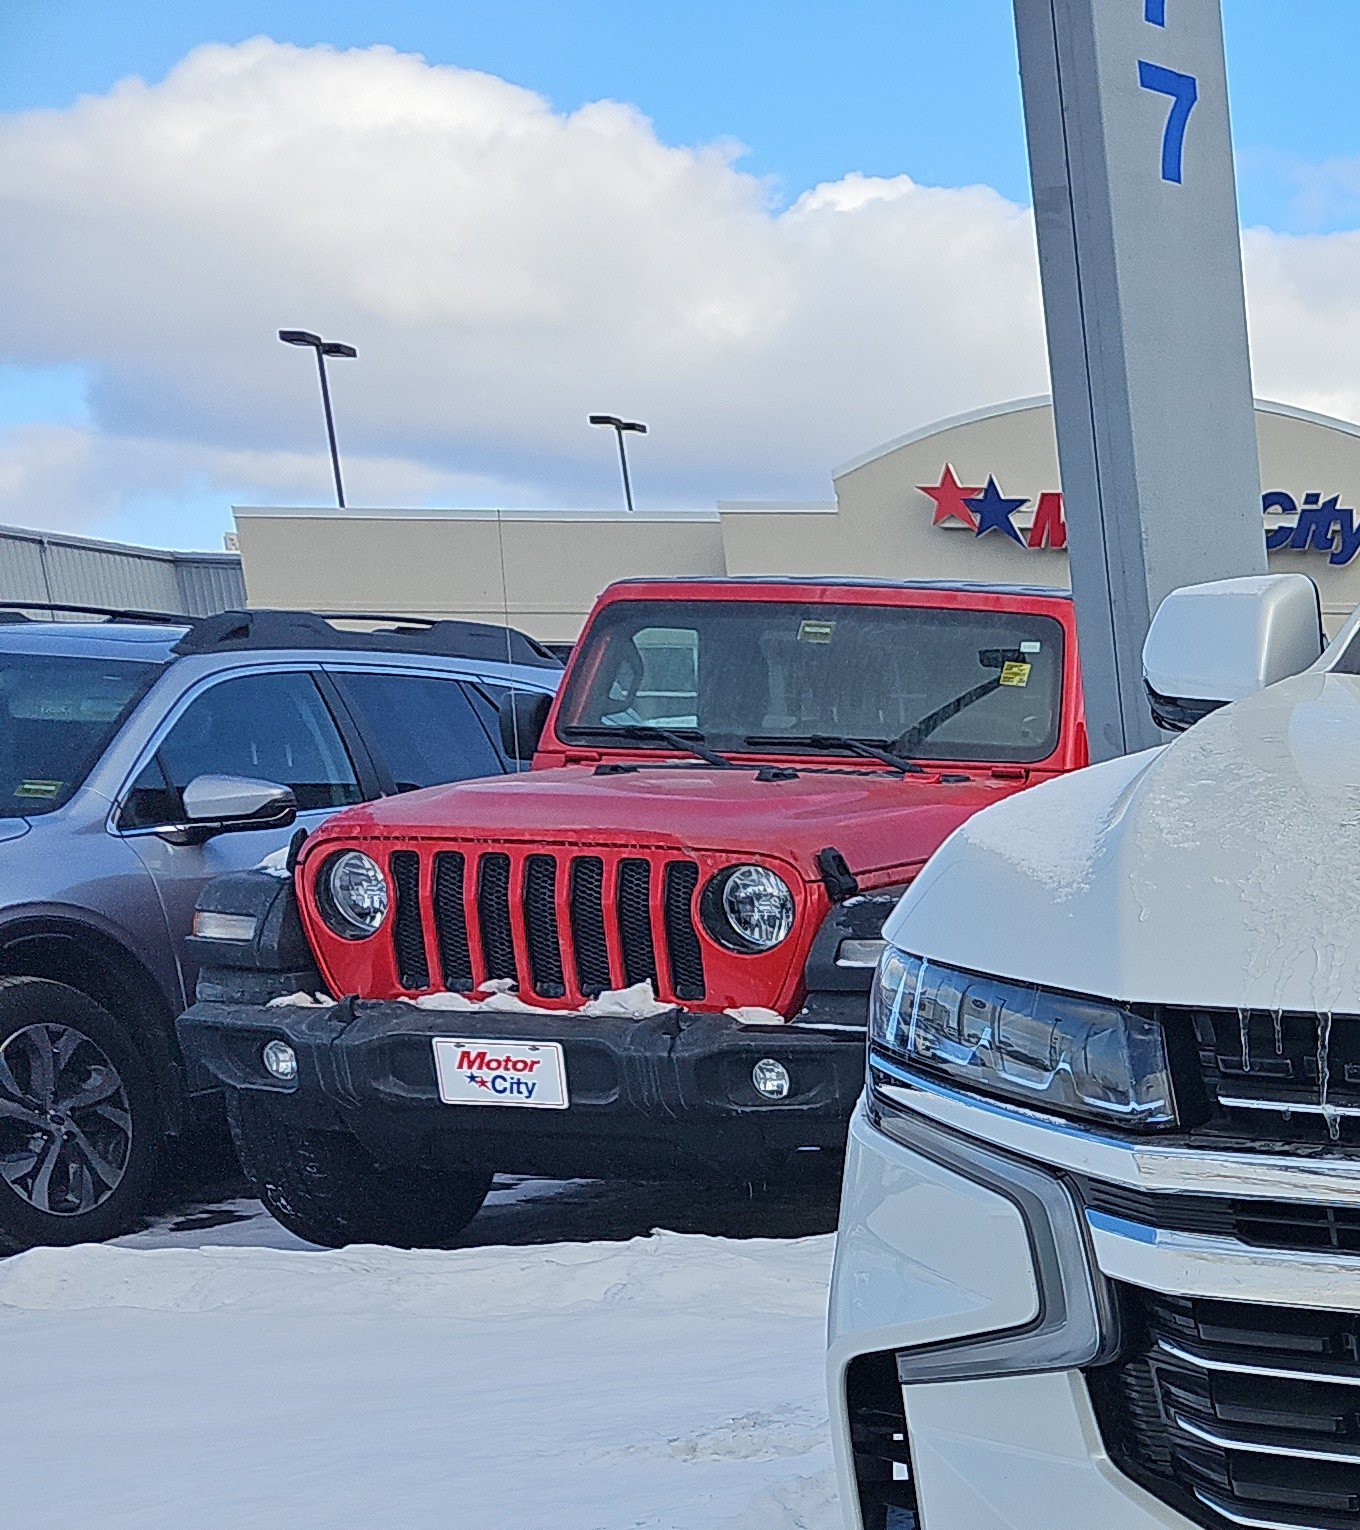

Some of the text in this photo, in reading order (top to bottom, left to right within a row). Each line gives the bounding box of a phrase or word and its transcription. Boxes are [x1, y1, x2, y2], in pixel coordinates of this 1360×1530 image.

[1137, 60, 1198, 185] 7
[455, 1050, 541, 1073] Motor
[490, 1074, 537, 1100] City
